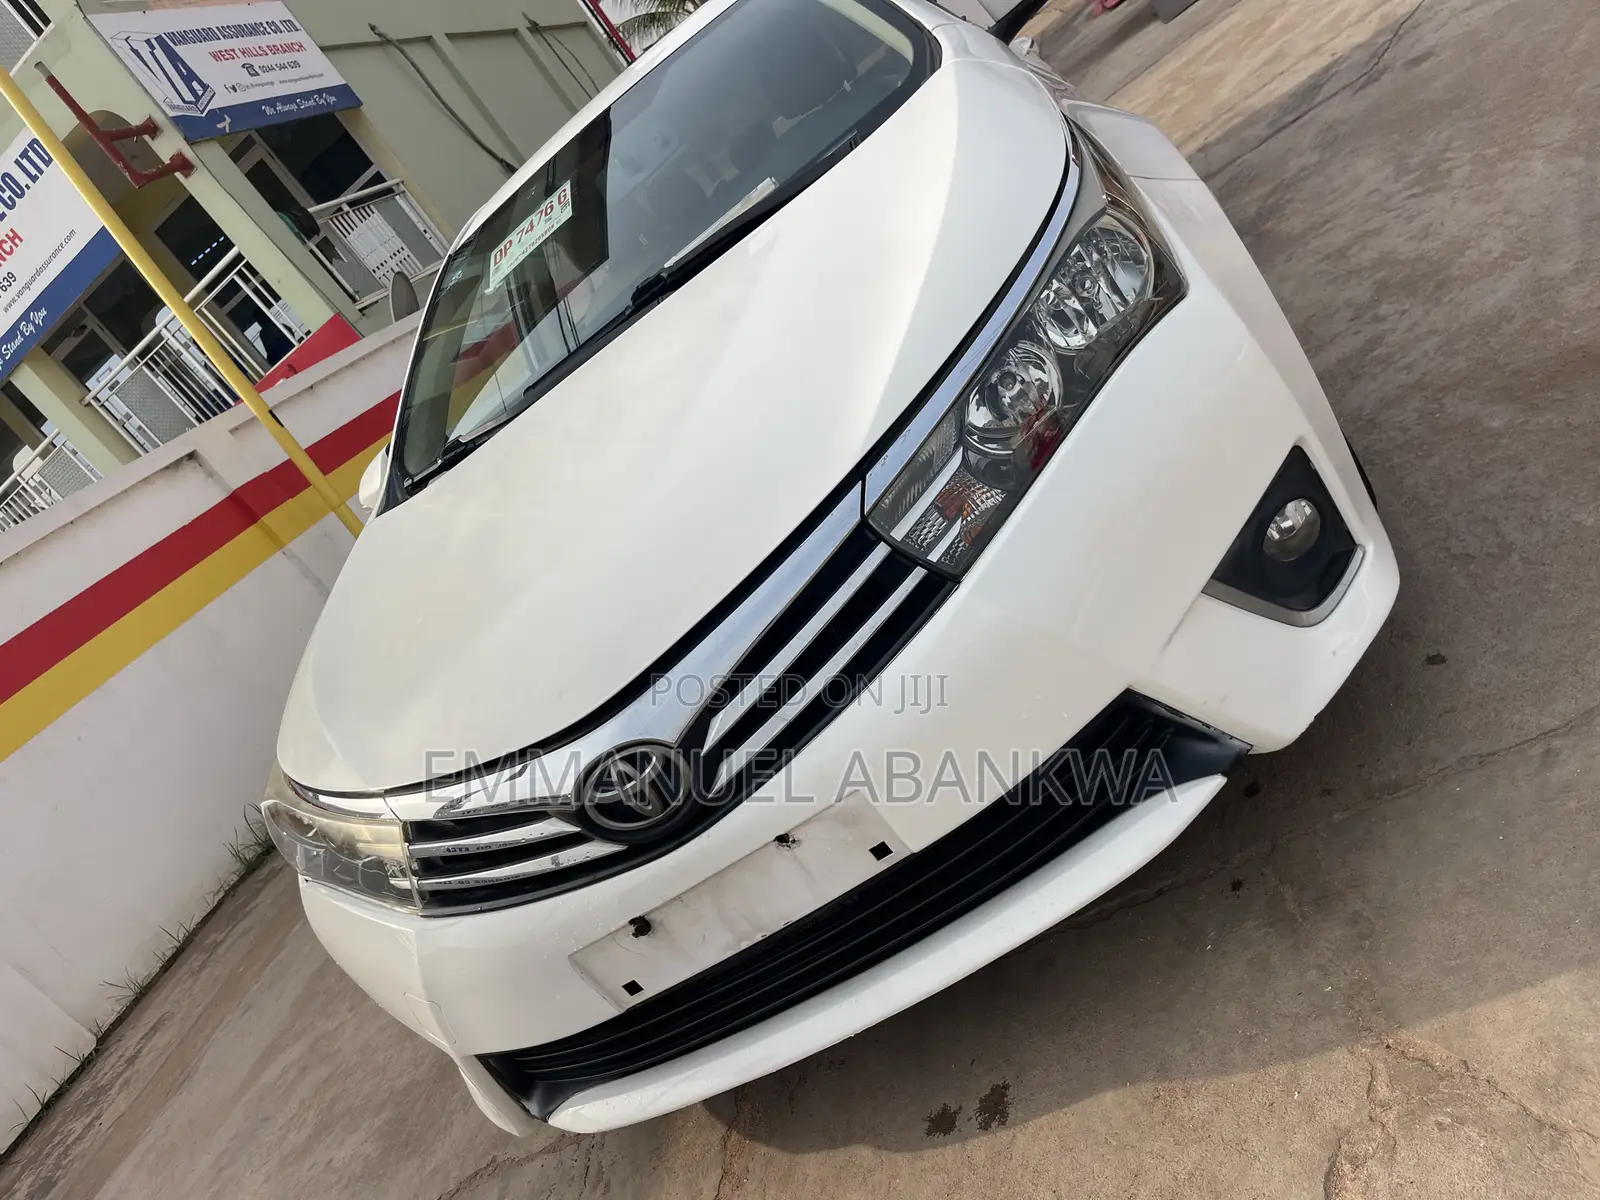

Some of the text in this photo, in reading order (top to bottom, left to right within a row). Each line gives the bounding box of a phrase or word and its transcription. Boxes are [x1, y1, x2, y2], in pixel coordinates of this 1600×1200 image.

[163, 19, 302, 47] VANGUARD ASSURANCE CO. LTD.
[208, 40, 306, 62] WEST HILLS BRANCH
[14, 138, 54, 184] LTD
[494, 239, 513, 267] DP
[516, 200, 554, 244] 7476
[558, 188, 568, 206] G
[3, 229, 77, 314] www.vanguardassurance.com
[2, 307, 48, 360] Stand By You
